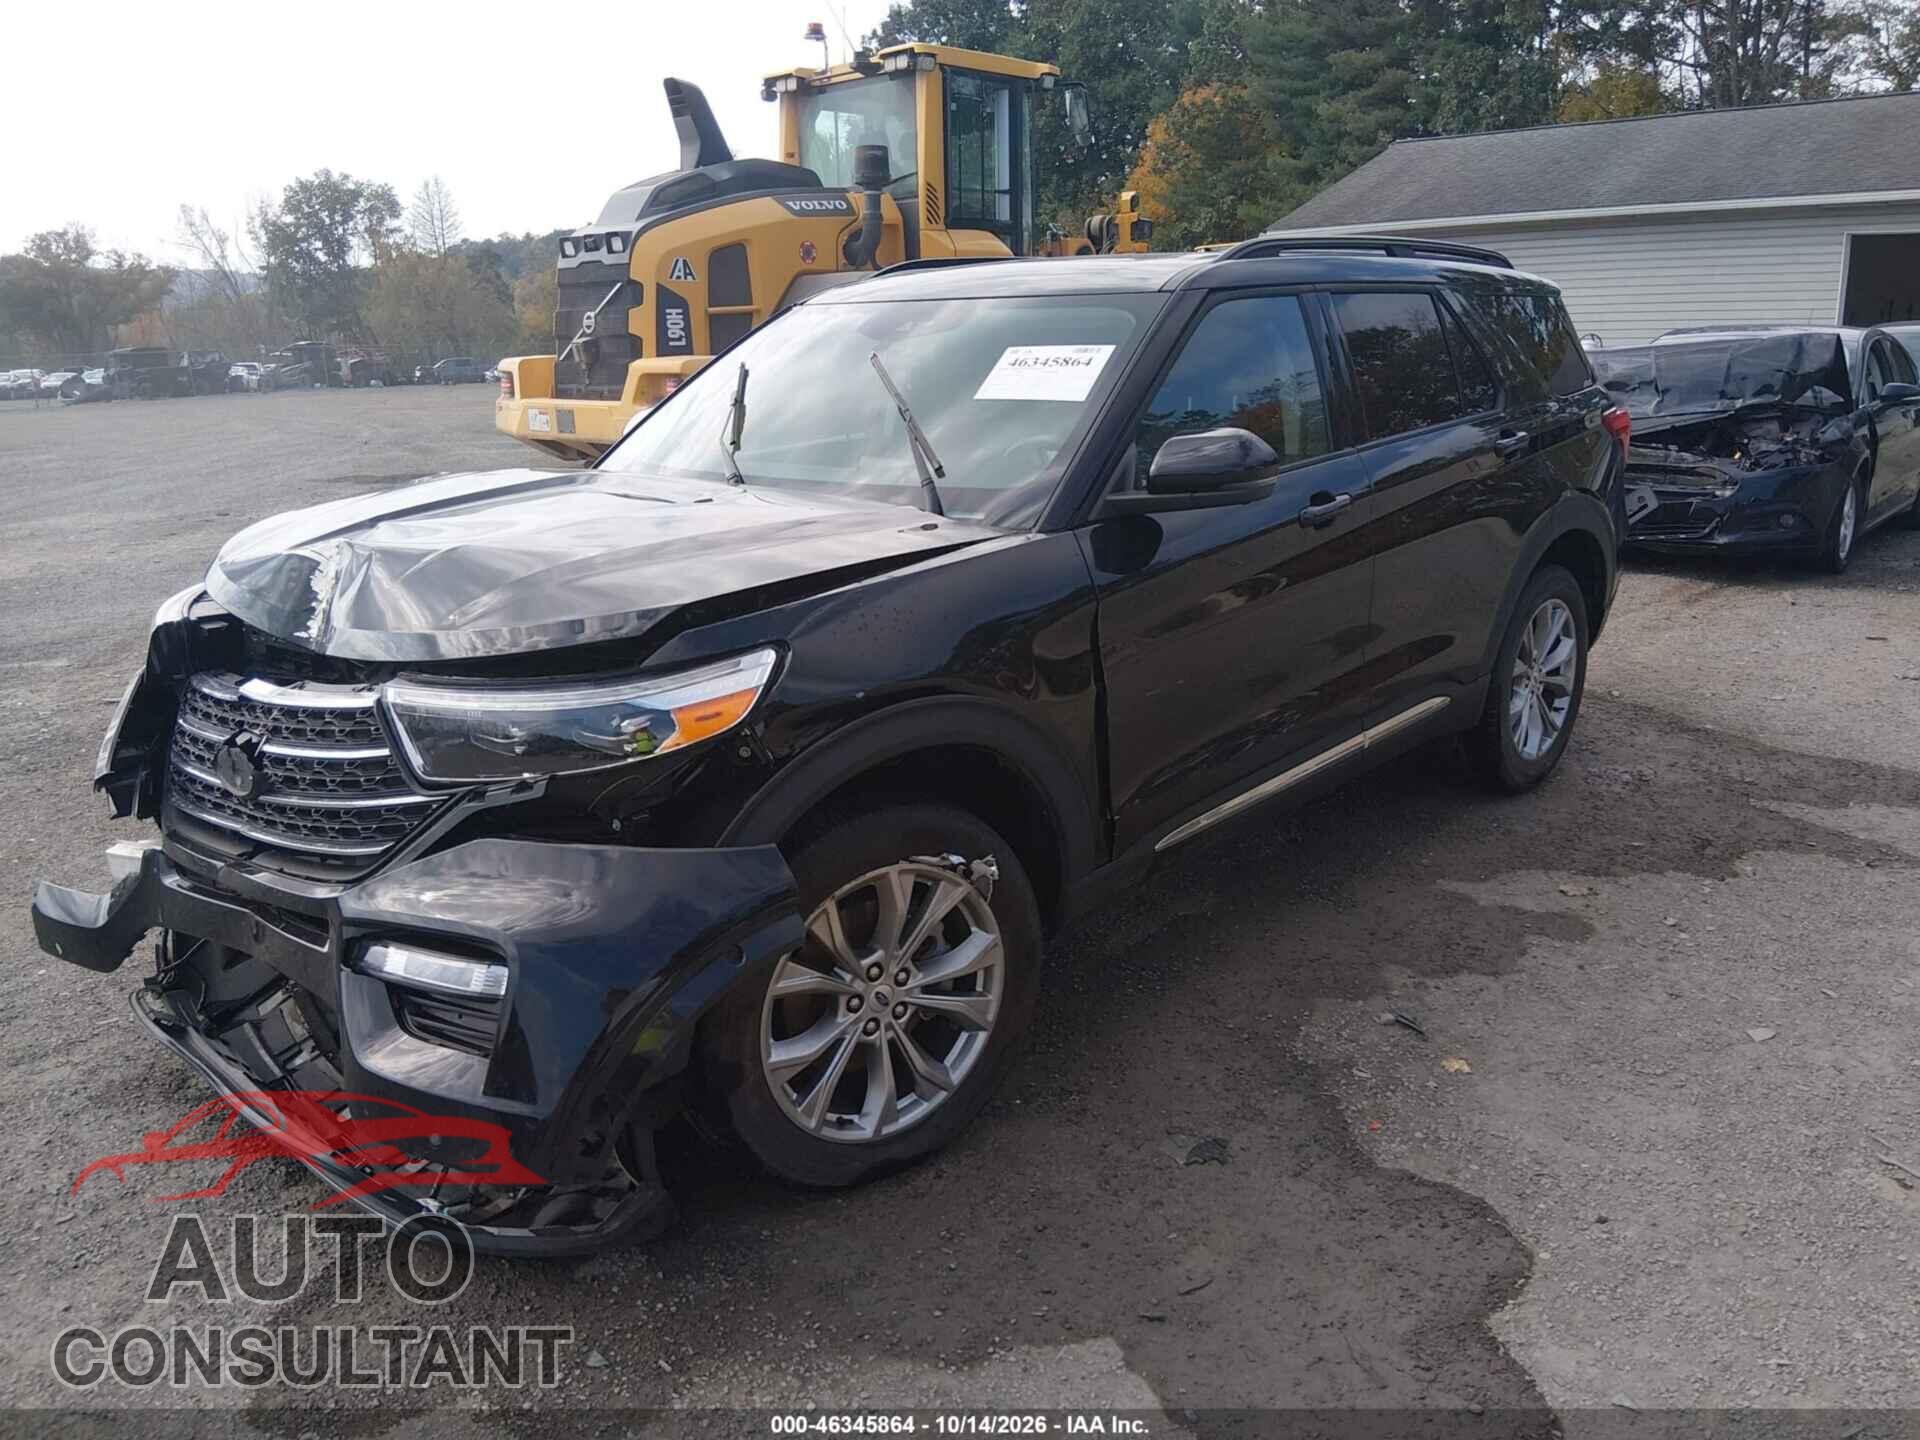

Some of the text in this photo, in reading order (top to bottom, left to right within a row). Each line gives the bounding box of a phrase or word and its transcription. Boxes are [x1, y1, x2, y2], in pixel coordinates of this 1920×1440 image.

[784, 199, 848, 211] VOLVO
[664, 307, 687, 347] L90H
[1008, 356, 1093, 368] 46345864
